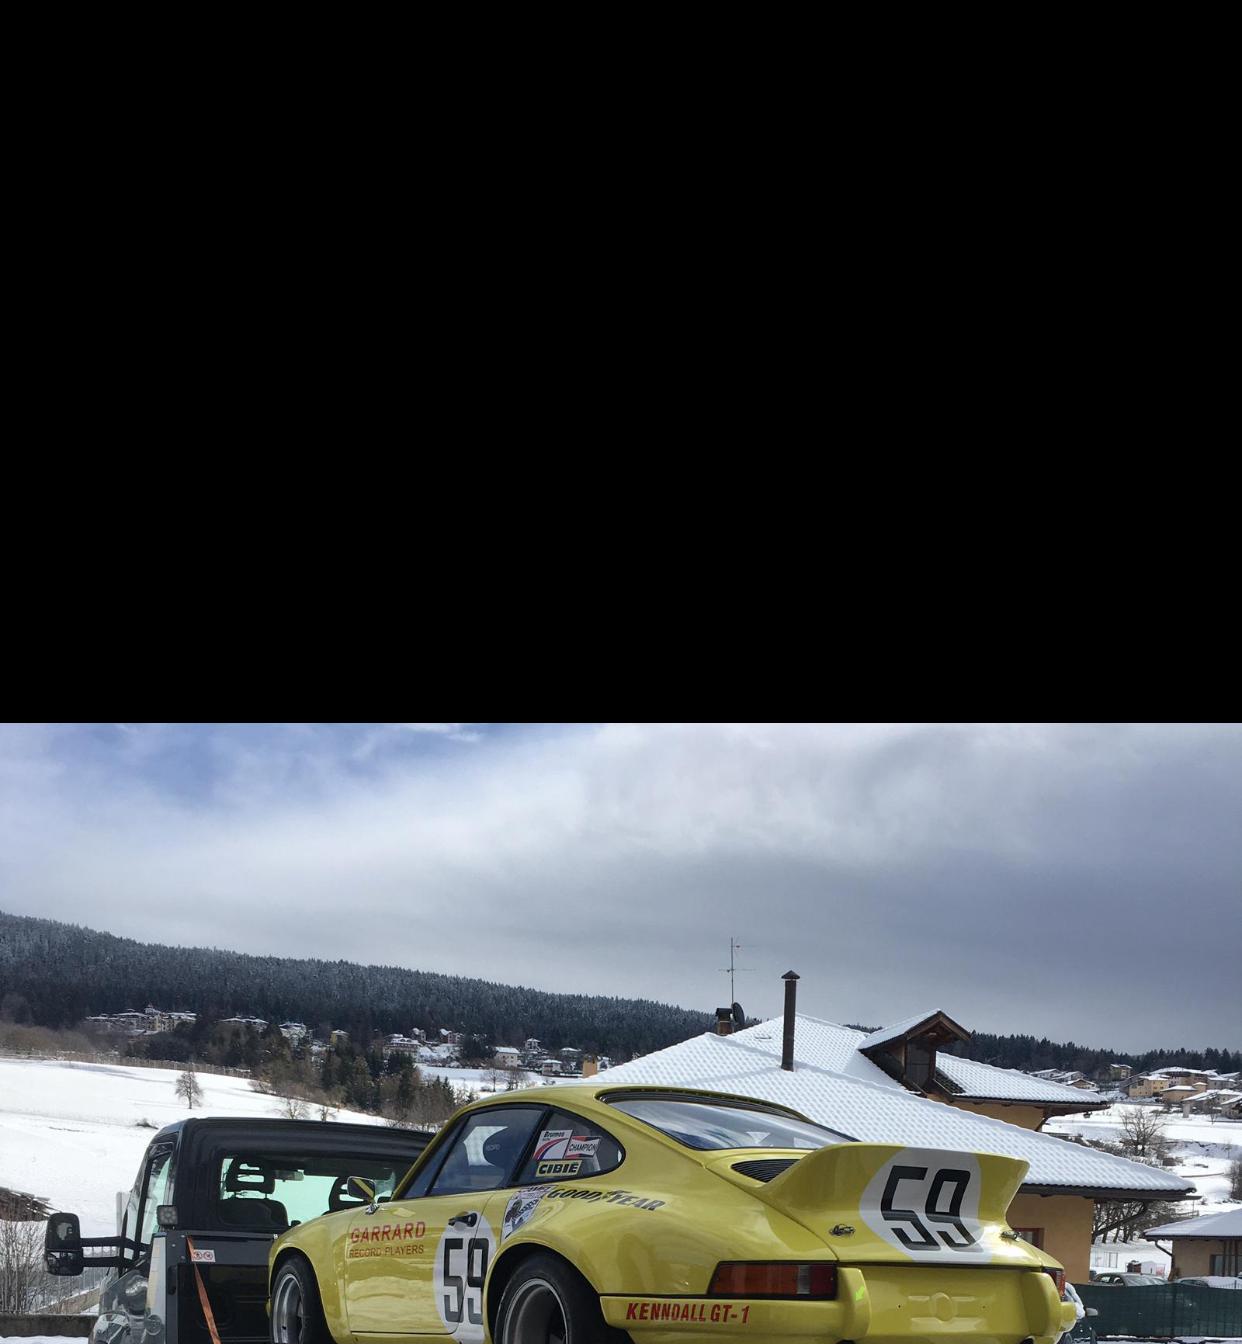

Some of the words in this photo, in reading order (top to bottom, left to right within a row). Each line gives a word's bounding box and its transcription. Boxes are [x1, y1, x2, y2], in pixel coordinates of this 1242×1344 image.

[880, 1165, 982, 1252] 59
[350, 1221, 426, 1244] GARRARD
[350, 1246, 382, 1259] RECORD
[384, 1244, 424, 1257] PLAYERS
[443, 1238, 489, 1325] 59
[626, 1303, 706, 1321] KENNDALL
